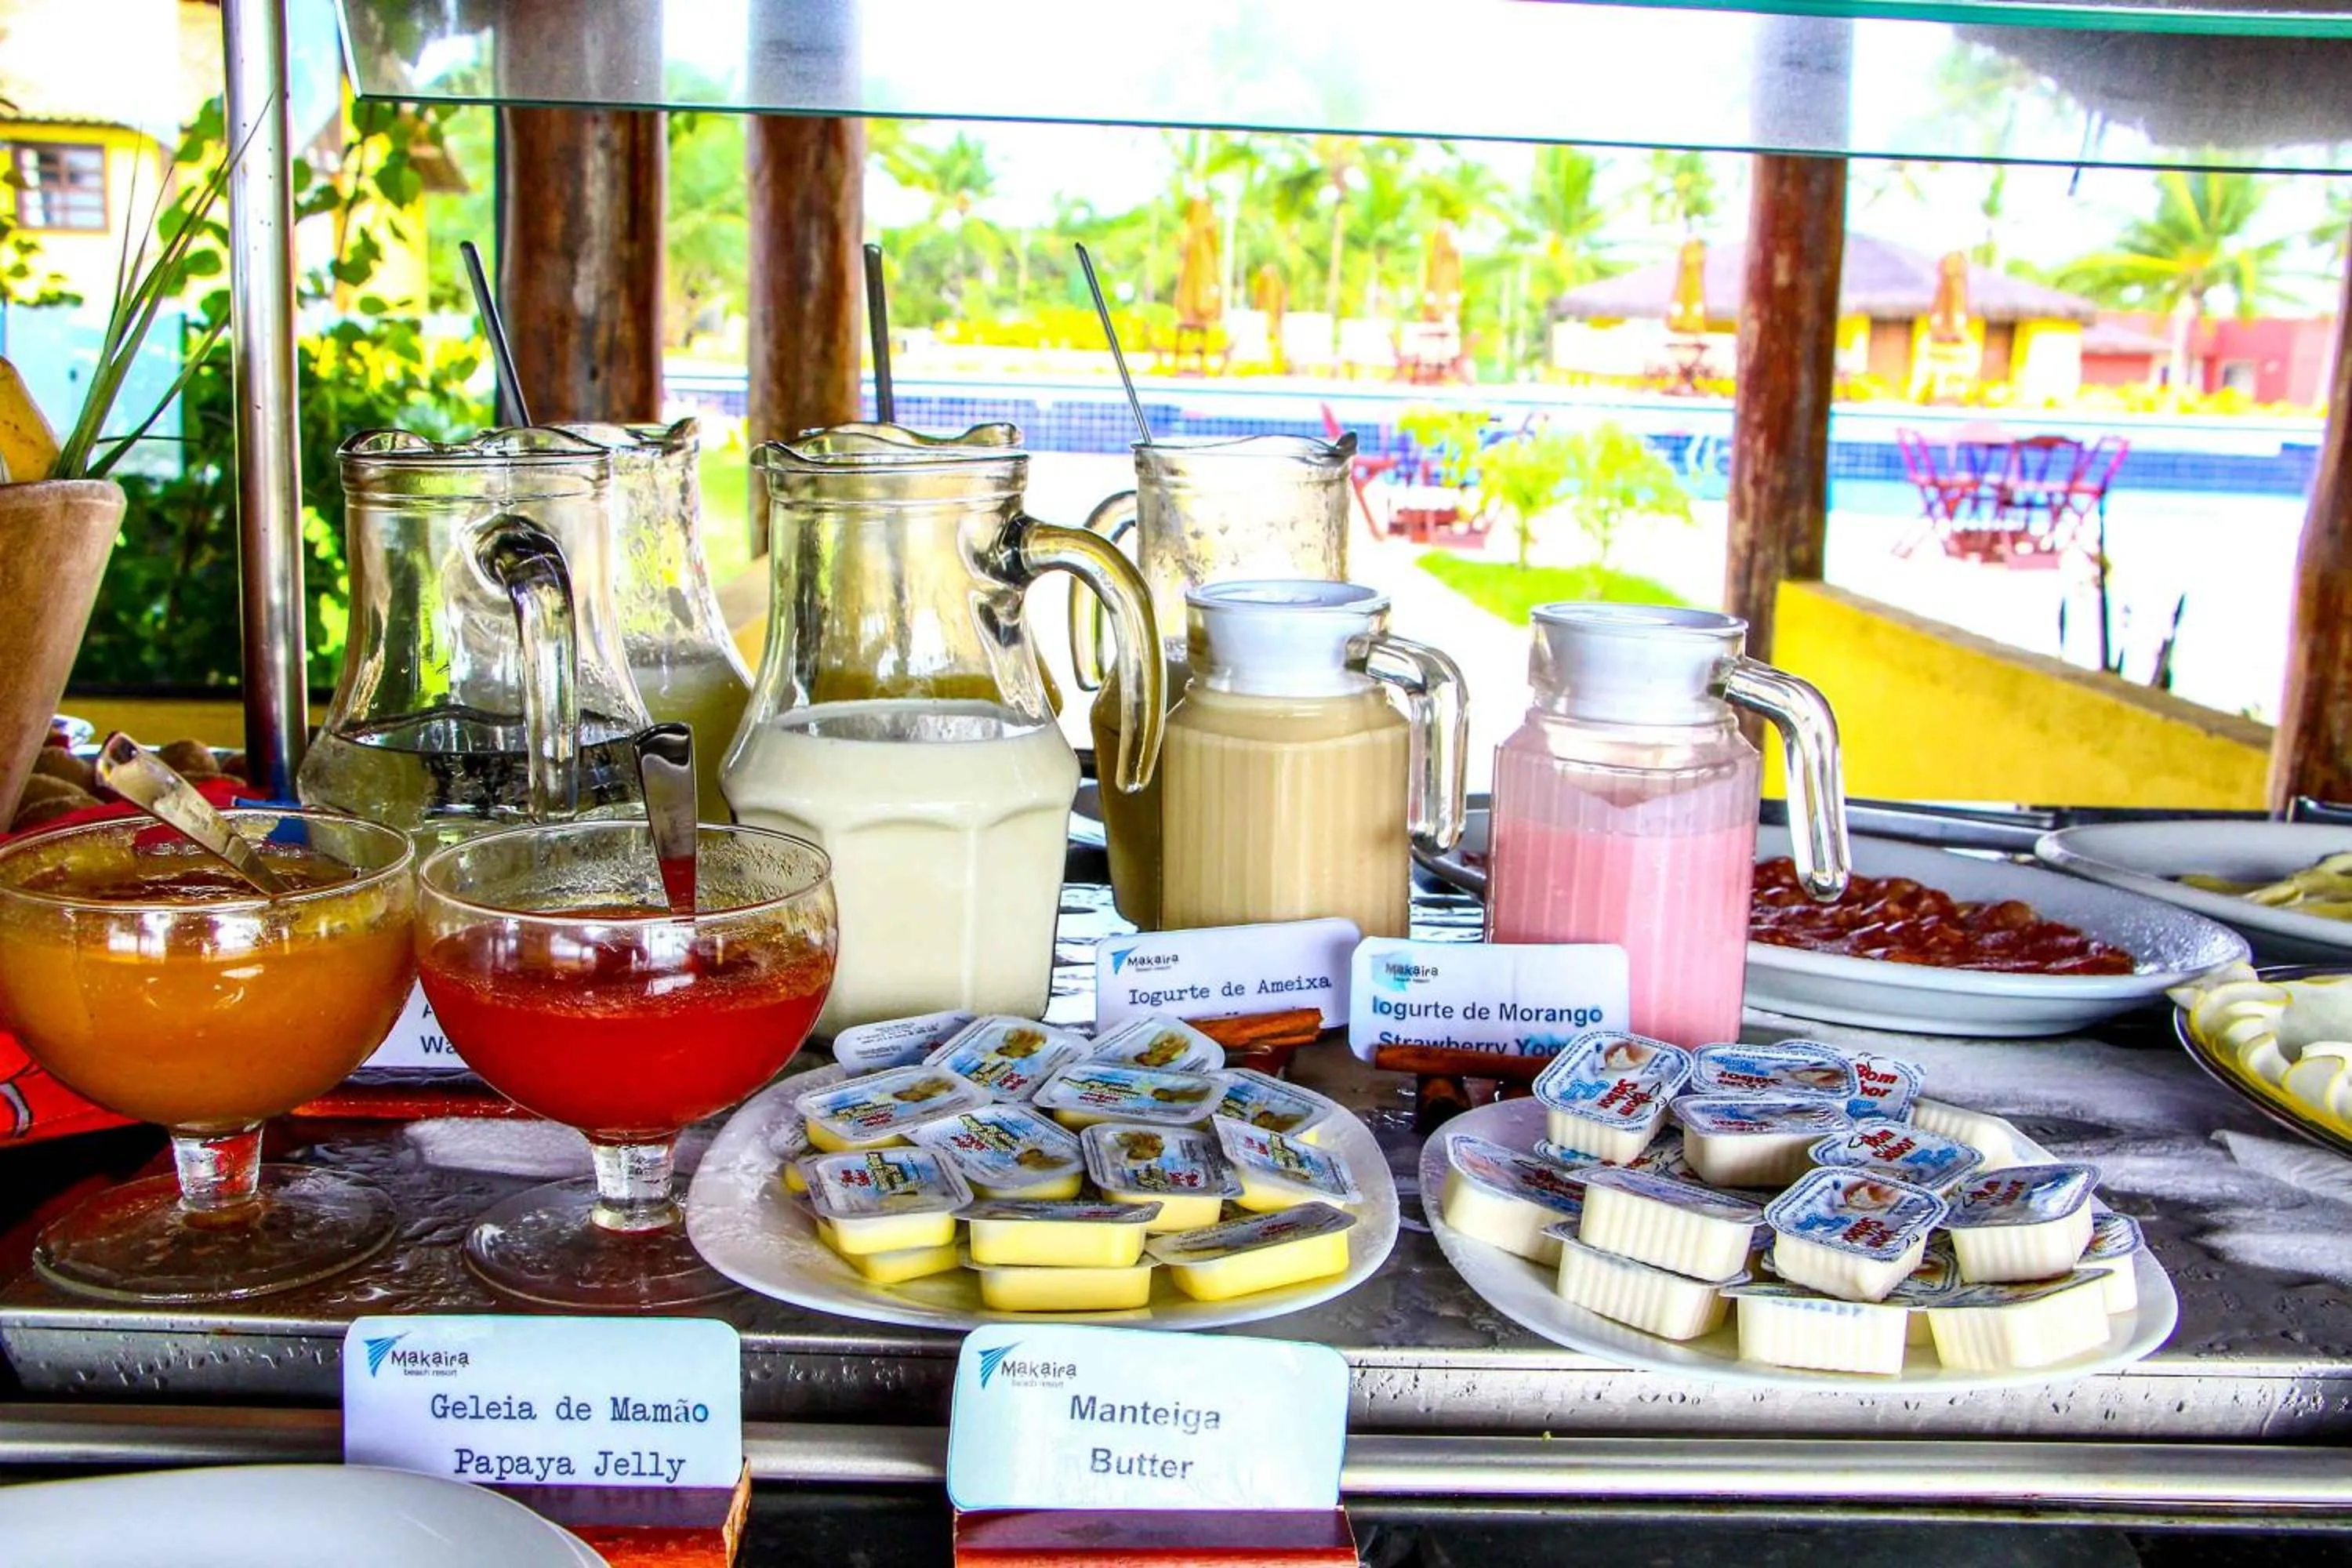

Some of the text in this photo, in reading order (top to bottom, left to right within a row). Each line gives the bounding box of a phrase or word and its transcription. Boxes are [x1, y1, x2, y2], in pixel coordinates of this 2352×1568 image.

[1128, 975, 1333, 1006] Iogurte de Ameixa
[1373, 996, 1603, 1028] Iogurte de Morango
[391, 1349, 470, 1367] Makaira
[1001, 1360, 1076, 1379] Makaira
[430, 1394, 710, 1423] Geleia de Mamão
[1069, 1395, 1221, 1436] Manteiga
[454, 1448, 687, 1484] Papaya Jelly
[1090, 1447, 1194, 1480] Butter
